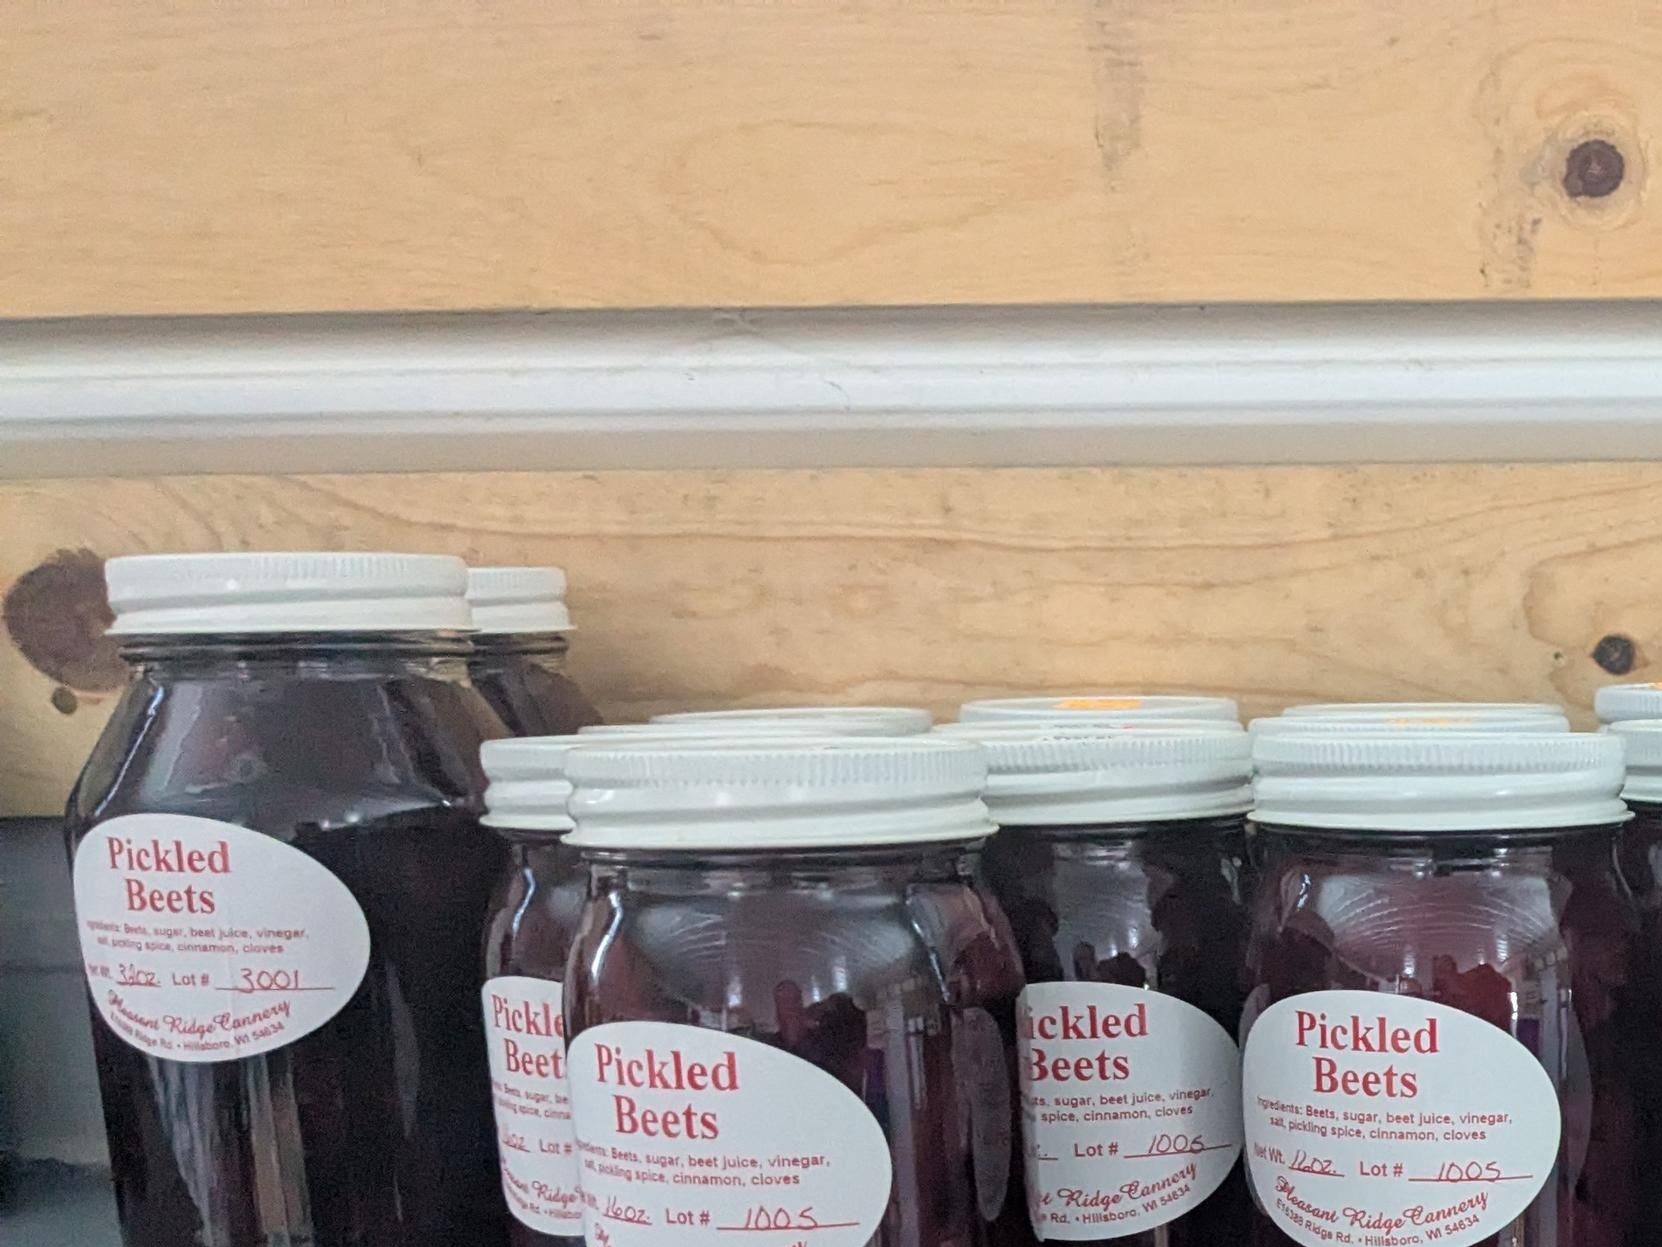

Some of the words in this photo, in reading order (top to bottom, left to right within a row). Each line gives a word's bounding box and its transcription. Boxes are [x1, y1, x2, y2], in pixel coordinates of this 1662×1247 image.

[107, 837, 231, 873] Pickled
[125, 878, 215, 914] Beets
[190, 927, 215, 937] beet
[243, 943, 283, 954] cloves
[173, 972, 197, 986] Lot
[201, 974, 209, 985] #
[239, 968, 299, 993] 3001
[108, 990, 159, 1031] Pleasant
[163, 1015, 215, 1036] Ridge
[214, 1000, 291, 1032] Cannery
[492, 994, 563, 1037] Pickle
[1028, 1003, 1149, 1040] ickled
[1296, 1010, 1440, 1054] Pickled
[504, 1038, 564, 1079] Beet
[595, 1043, 740, 1091] Pickled
[1313, 1056, 1418, 1098] Beets
[1041, 1111, 1078, 1123] spice,
[1084, 1110, 1150, 1122] cinnamon,
[1155, 1105, 1192, 1118] cloves
[1054, 1095, 1095, 1108] sugar,
[1100, 1094, 1128, 1106] beet
[1130, 1093, 1165, 1106] juice,
[614, 1095, 719, 1140] Beets
[1306, 1105, 1339, 1121] Beets,
[1343, 1111, 1381, 1124] sugar,
[1386, 1112, 1414, 1124] beet
[1419, 1112, 1454, 1126] juice,
[1460, 1112, 1512, 1125] vinegar,
[1289, 1119, 1327, 1137] pickling
[1331, 1126, 1365, 1139] spice,
[1369, 1128, 1438, 1142] cinnamon,
[1443, 1128, 1486, 1141] cloves
[612, 1147, 642, 1163] Beets,
[646, 1153, 681, 1167] sugar,
[688, 1154, 717, 1167] beet
[722, 1154, 762, 1170] juice,
[768, 1155, 830, 1169] vinegar,
[1075, 1144, 1103, 1157] Lot
[1108, 1142, 1119, 1154] #
[636, 1170, 668, 1185] spice,
[673, 1173, 746, 1187] cinnamon,
[752, 1173, 800, 1186] cloves
[1360, 1162, 1388, 1177] Lot
[1393, 1163, 1403, 1177] #
[1438, 1161, 1501, 1183] 1005
[1058, 1189, 1123, 1212] Ridge
[1121, 1162, 1197, 1201] Cannery
[1142, 1201, 1158, 1213] WI
[1161, 1184, 1191, 1206] 54634
[666, 1209, 695, 1225] Lot
[700, 1210, 710, 1225] #
[746, 1206, 818, 1230] 1005
[1275, 1175, 1339, 1224] Pleasant
[1343, 1207, 1406, 1237] Ridge
[1403, 1191, 1488, 1225] Cannery
[1305, 1220, 1333, 1240] Ridge
[1336, 1231, 1354, 1244] Rd.
[1426, 1227, 1442, 1241] WI
[1445, 1214, 1480, 1235] 54634
